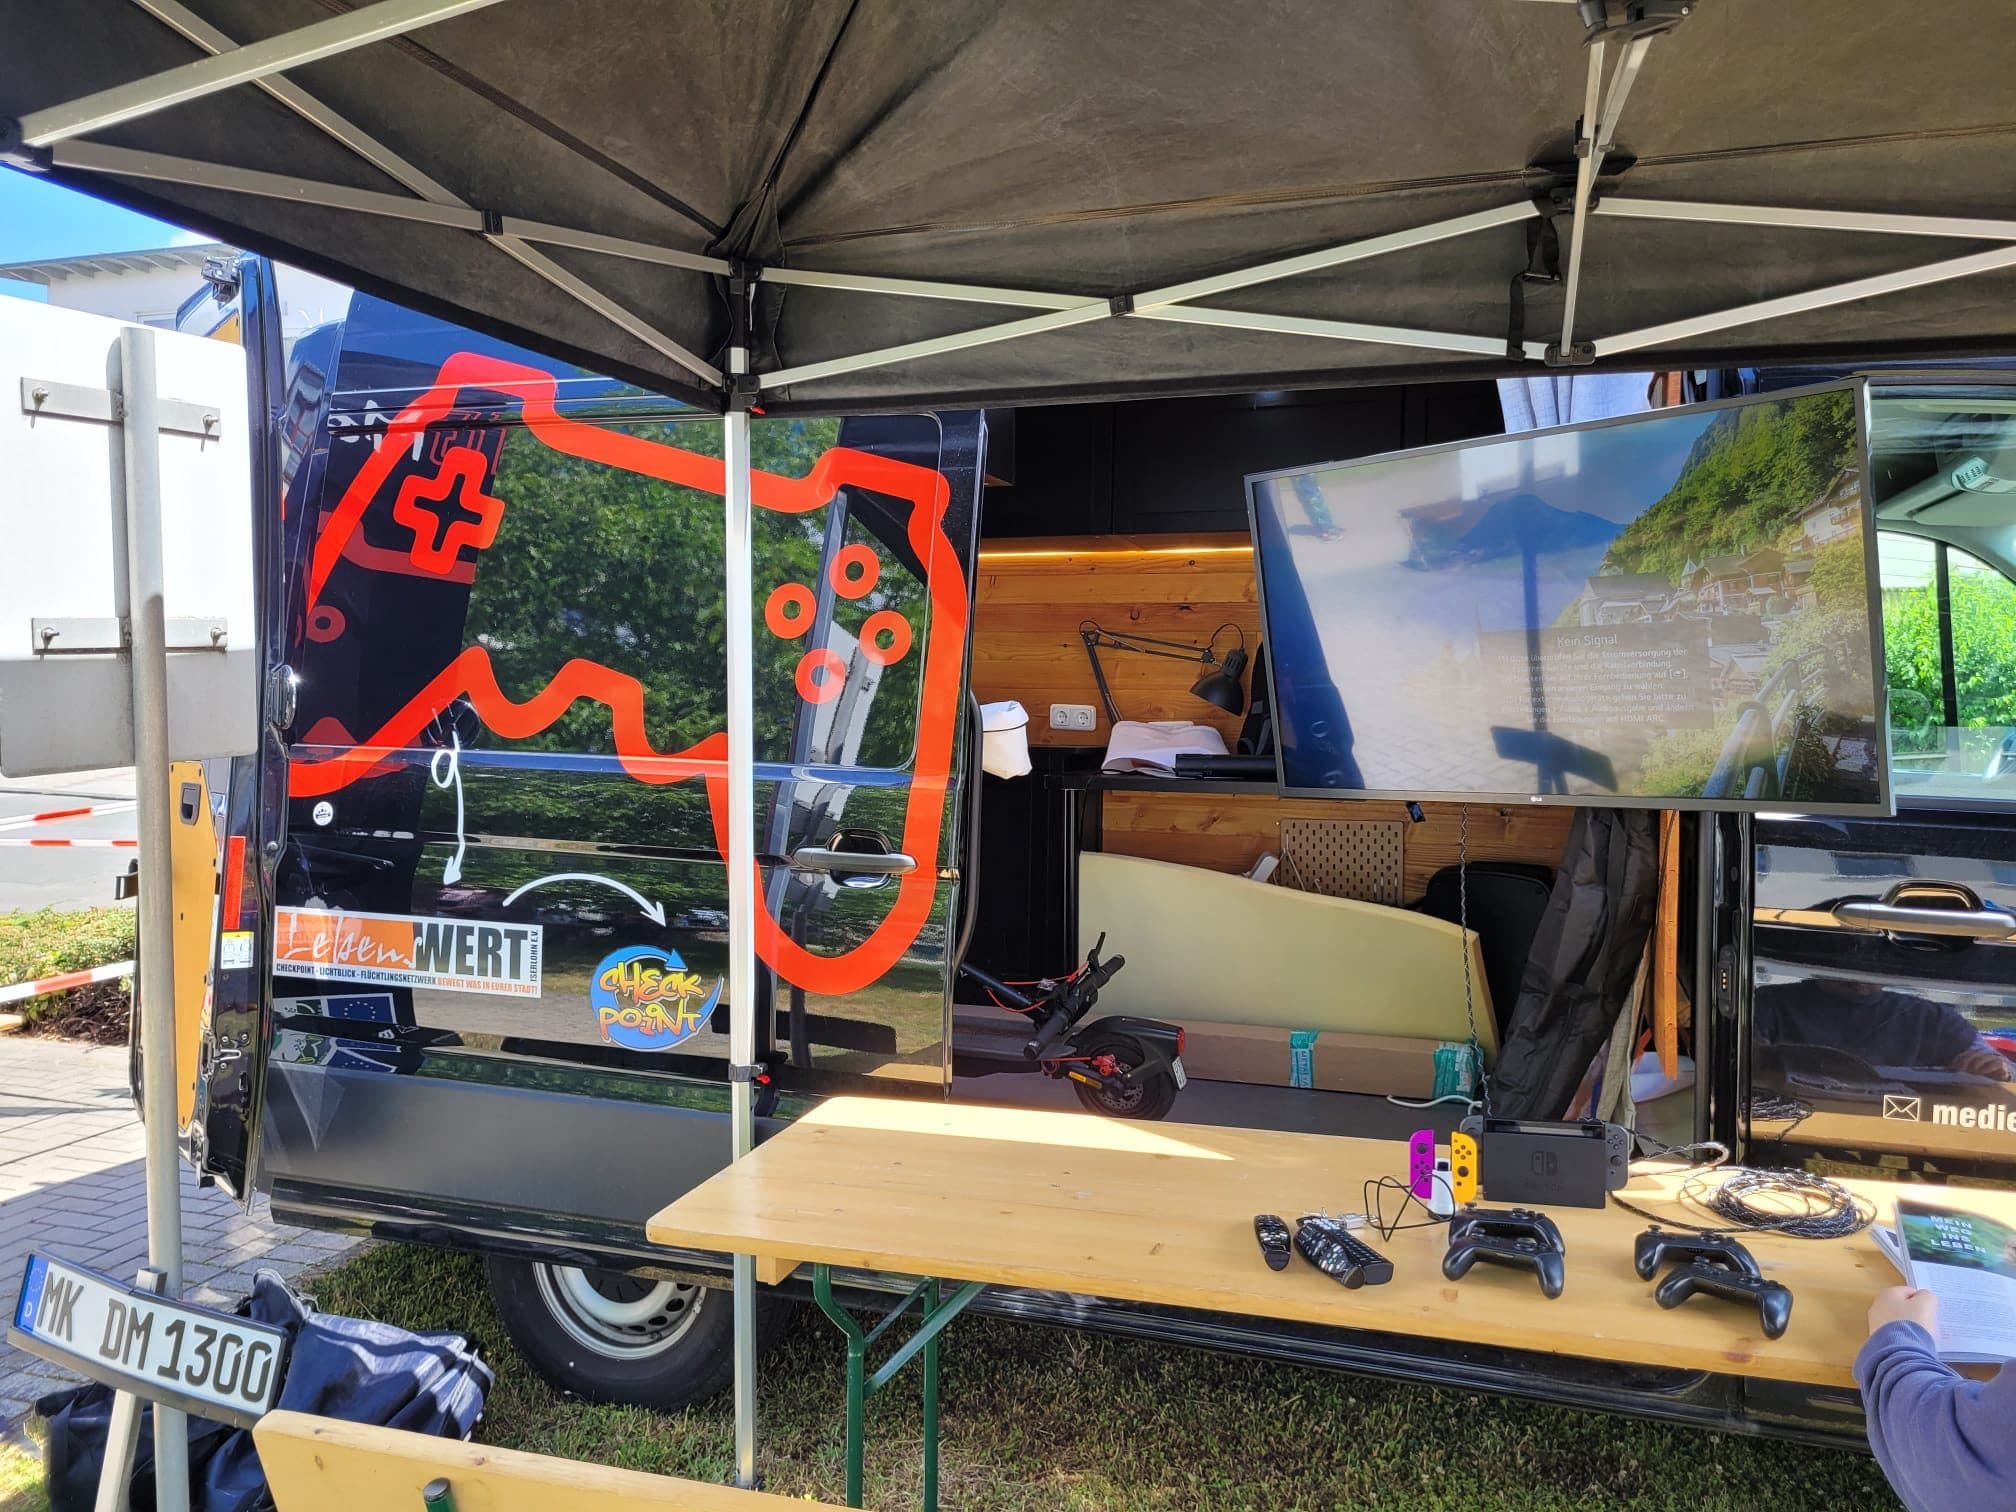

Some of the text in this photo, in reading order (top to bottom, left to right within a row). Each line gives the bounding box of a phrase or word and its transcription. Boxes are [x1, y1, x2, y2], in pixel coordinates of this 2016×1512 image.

[1557, 633, 1617, 648] Kein Signal
[276, 962, 315, 975] CHECKPOINT
[320, 966, 356, 978] LICHTBLICK
[361, 970, 436, 986] FLÜCHTLINGSNETZWERK
[466, 979, 481, 989] WAS
[529, 944, 538, 982] ISERLOHN
[600, 962, 704, 1004] CHECK
[24, 1271, 273, 1404] D MK DM 1300
